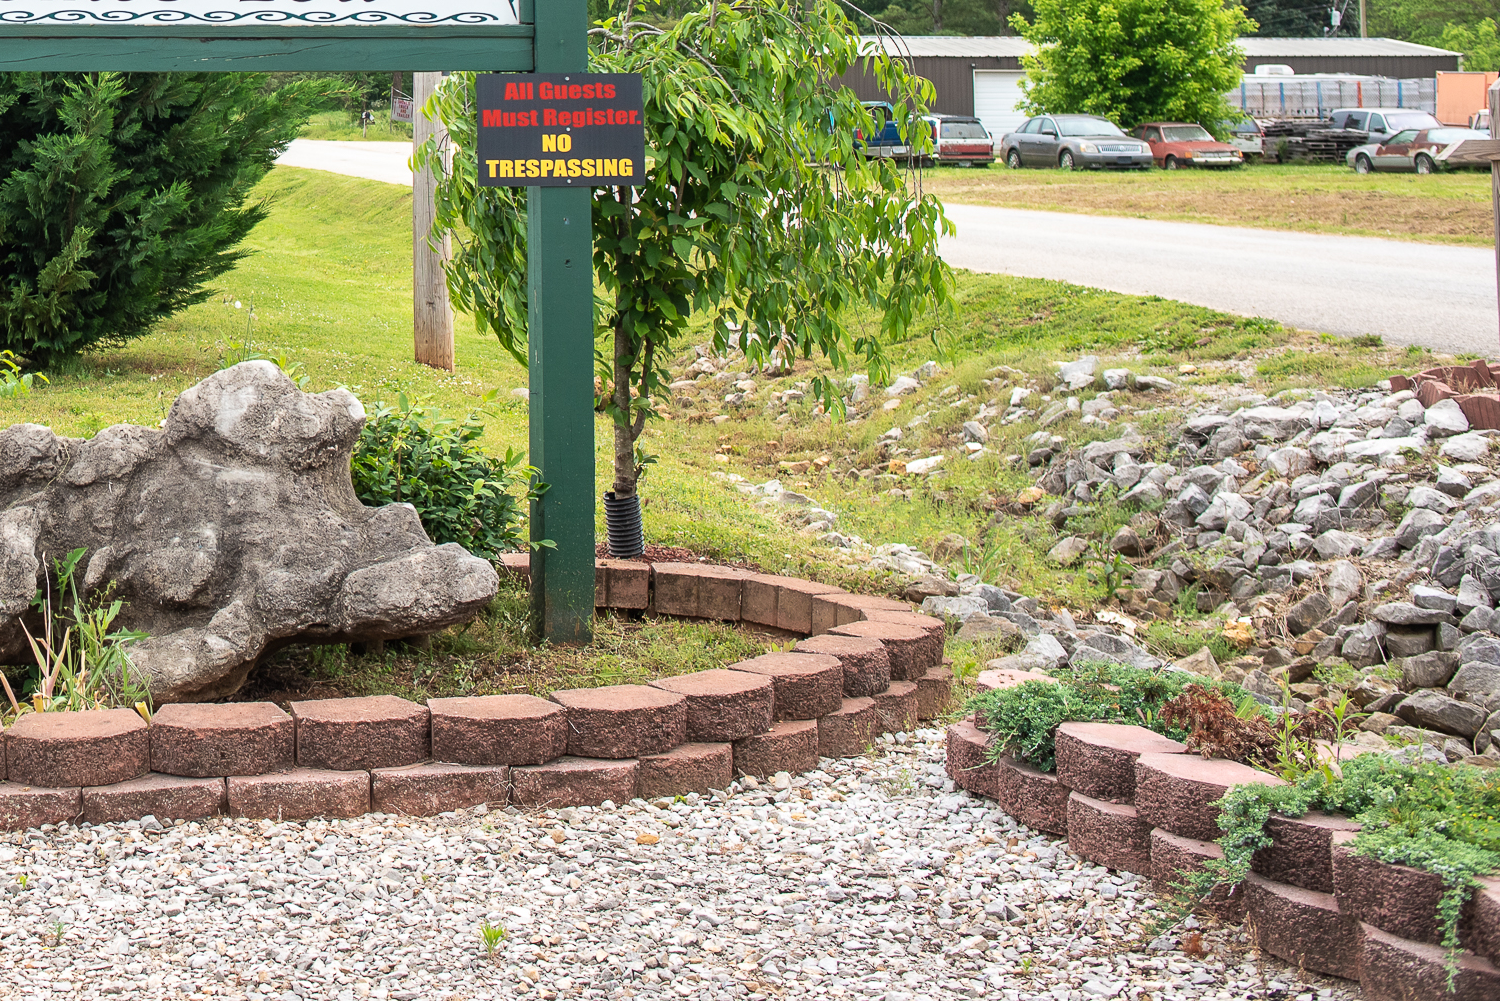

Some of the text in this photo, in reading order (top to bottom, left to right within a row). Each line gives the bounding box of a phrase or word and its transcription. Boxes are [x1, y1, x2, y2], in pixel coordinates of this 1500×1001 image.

[504, 82, 616, 100] All Guests
[482, 108, 642, 128] Must Register.
[541, 134, 572, 152] NO
[485, 158, 633, 178] TRESPASSING
